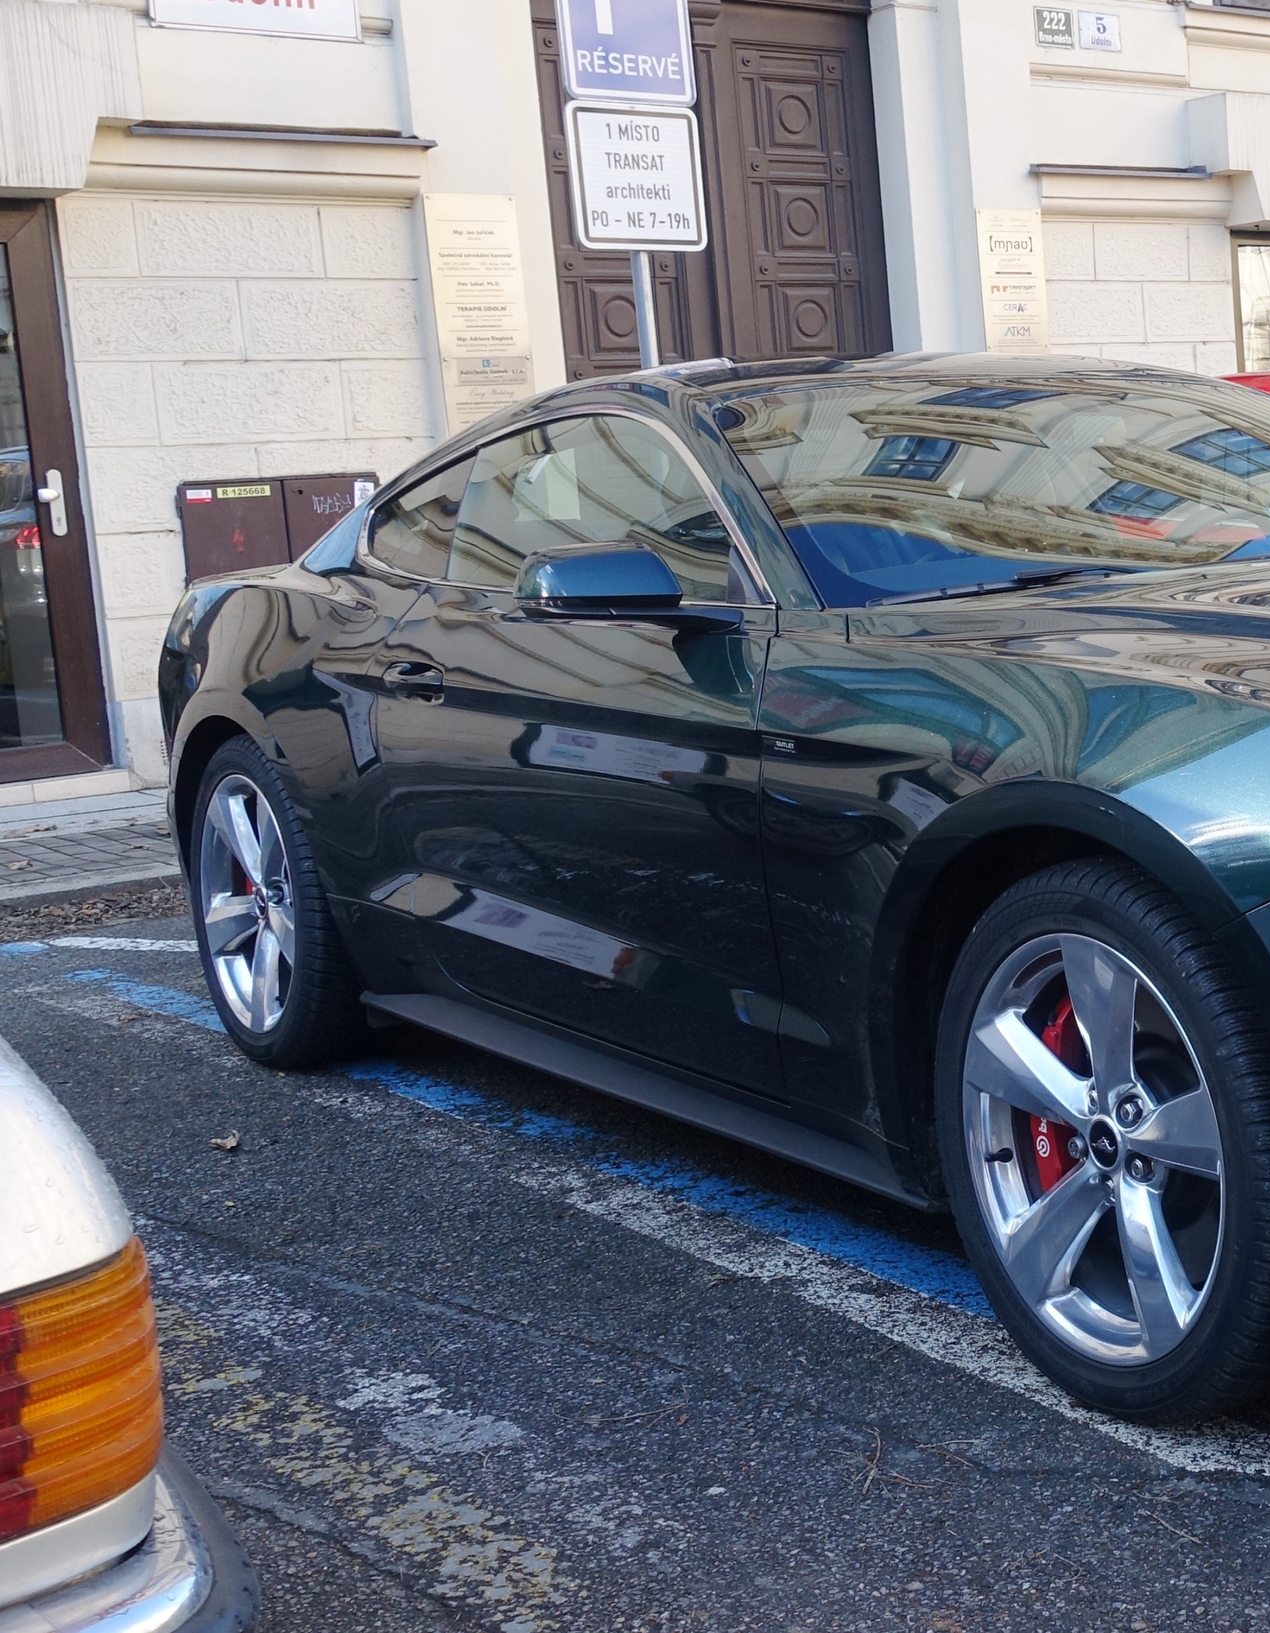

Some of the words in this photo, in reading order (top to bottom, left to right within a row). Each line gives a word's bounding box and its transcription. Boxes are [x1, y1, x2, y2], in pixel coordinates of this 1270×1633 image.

[1042, 11, 1067, 31] 222
[1094, 16, 1107, 34] 5
[576, 46, 681, 80] RÉSERVÉ
[605, 122, 613, 140] 1
[617, 120, 660, 142] MÍSTO
[605, 152, 665, 172] TRANSAT
[606, 183, 672, 201] architekti
[591, 210, 609, 228] PO
[627, 211, 646, 229] NE
[649, 212, 691, 230] 7-19h
[222, 488, 229, 496] R
[231, 487, 266, 496] 125668
